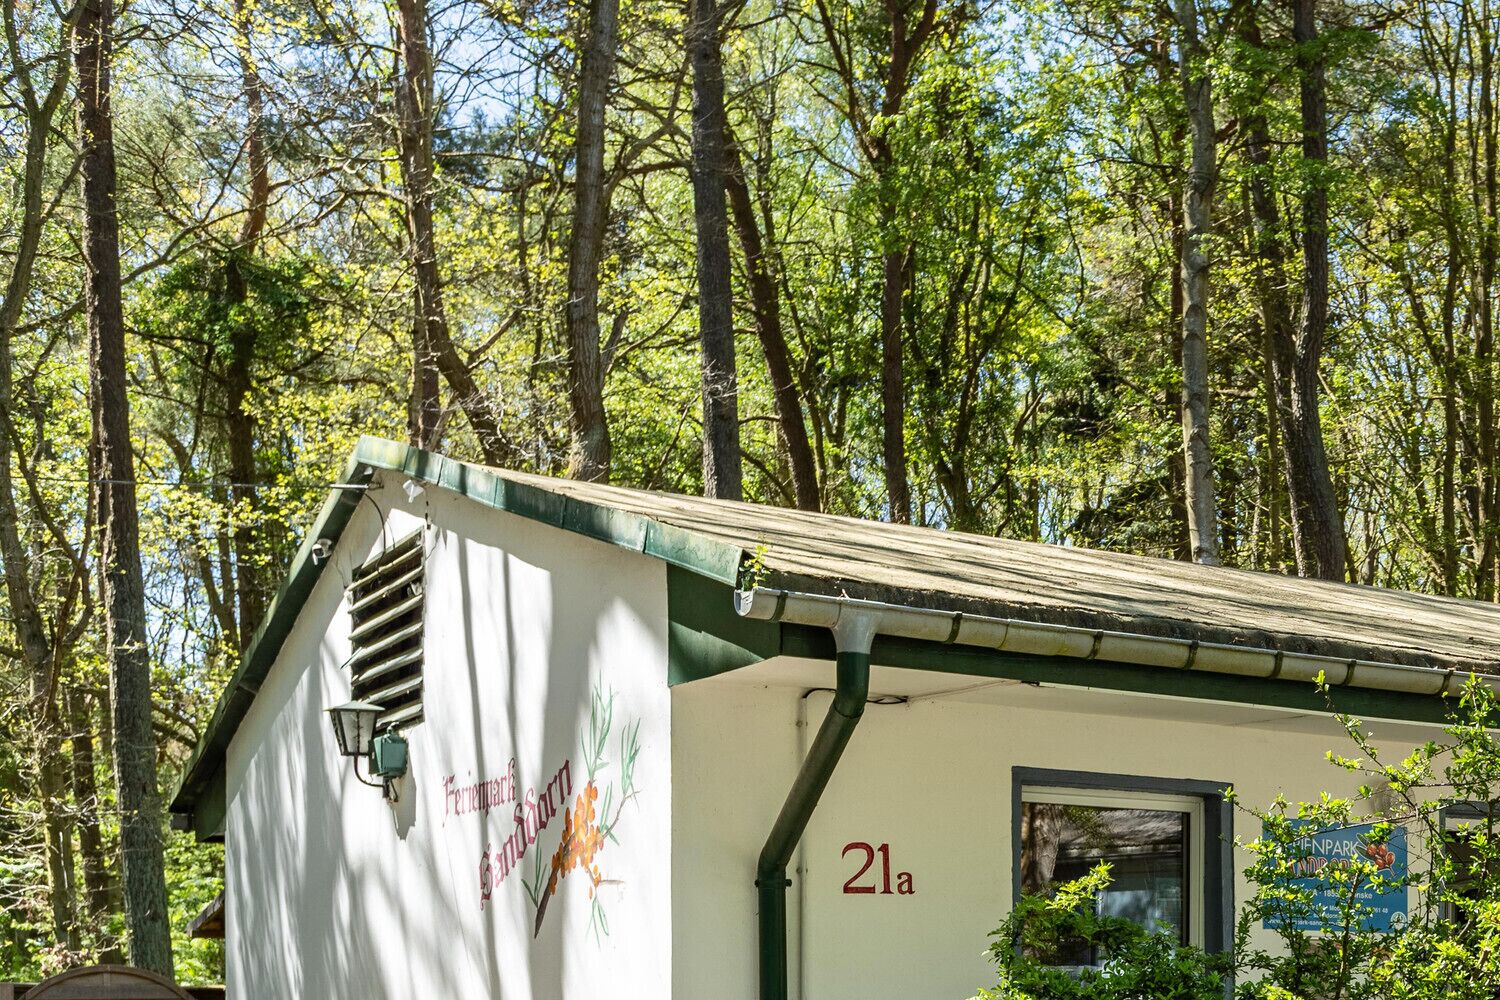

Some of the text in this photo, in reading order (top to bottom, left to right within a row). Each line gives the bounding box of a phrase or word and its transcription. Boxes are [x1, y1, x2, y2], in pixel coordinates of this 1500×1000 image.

[442, 757, 516, 828] Ferienpark
[479, 759, 573, 911] Sanddorn
[841, 841, 916, 895] 21a
